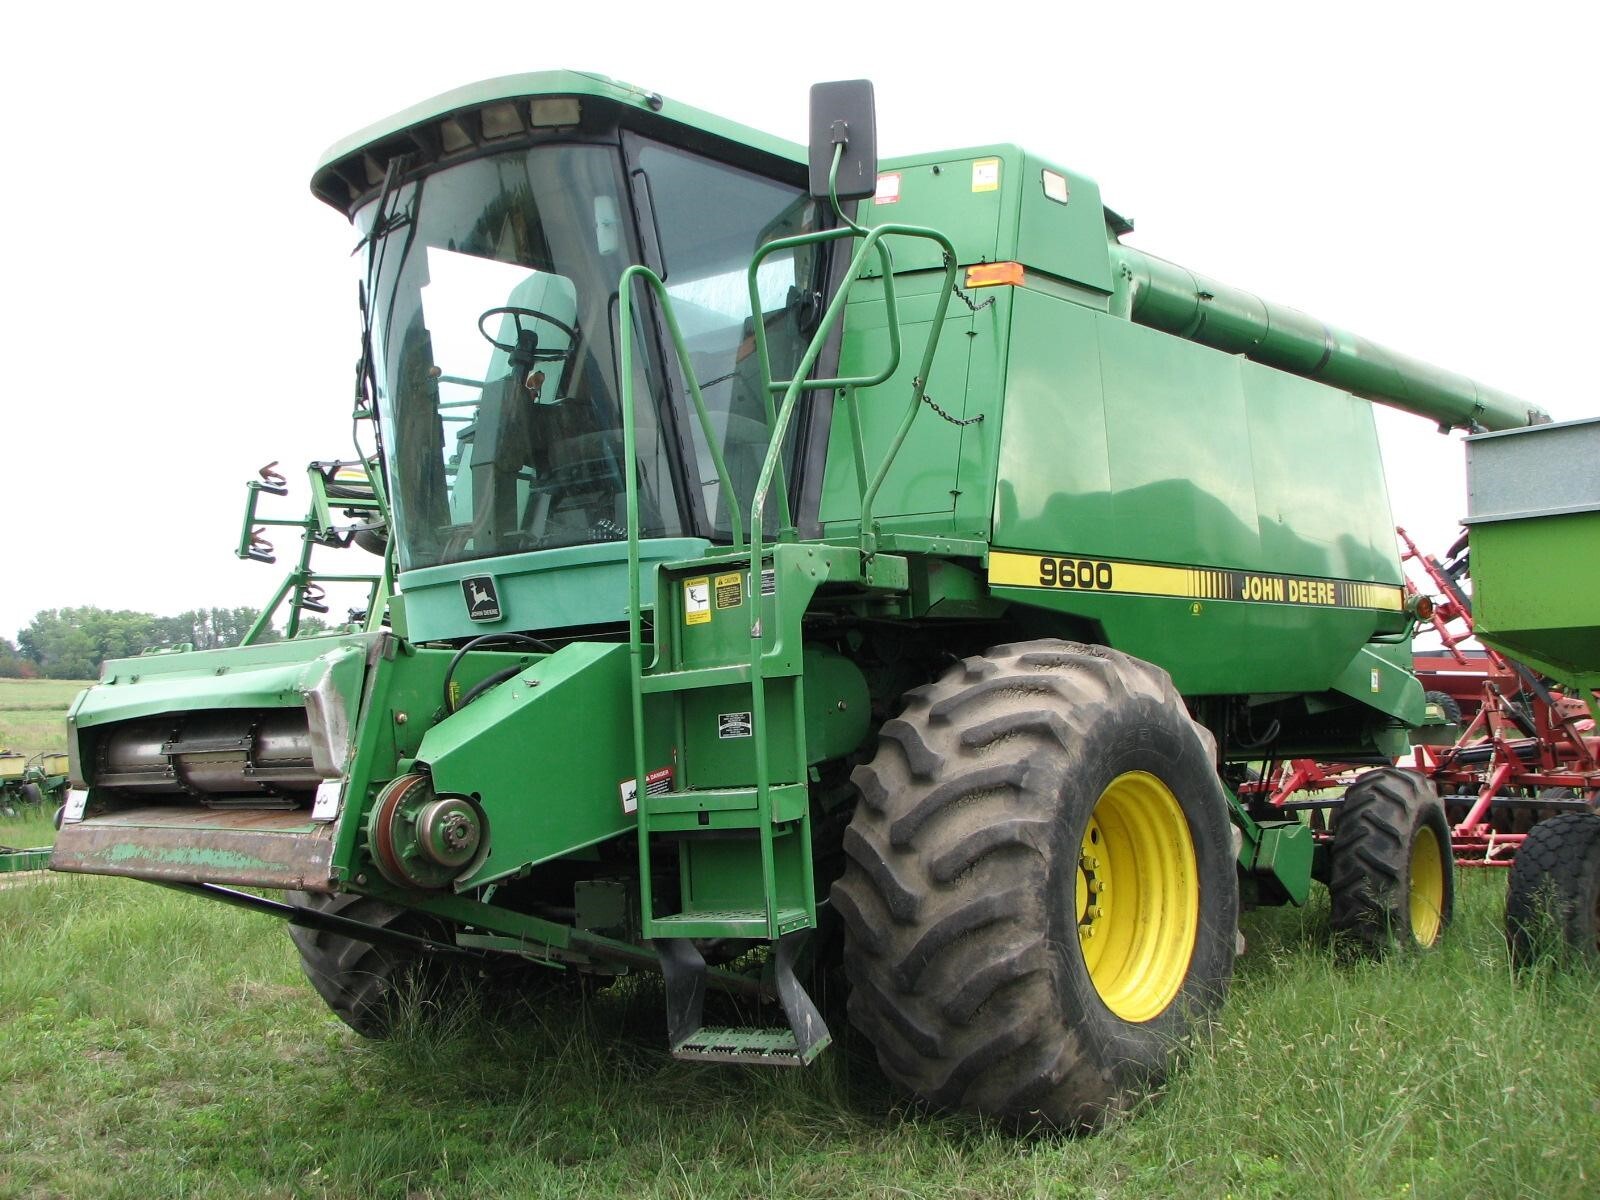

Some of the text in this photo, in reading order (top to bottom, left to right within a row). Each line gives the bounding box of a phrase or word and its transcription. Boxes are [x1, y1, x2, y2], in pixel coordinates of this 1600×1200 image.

[1039, 558, 1112, 590] 9600
[1241, 576, 1335, 605] JOHN DEERE
[649, 769, 670, 780] DANGER
